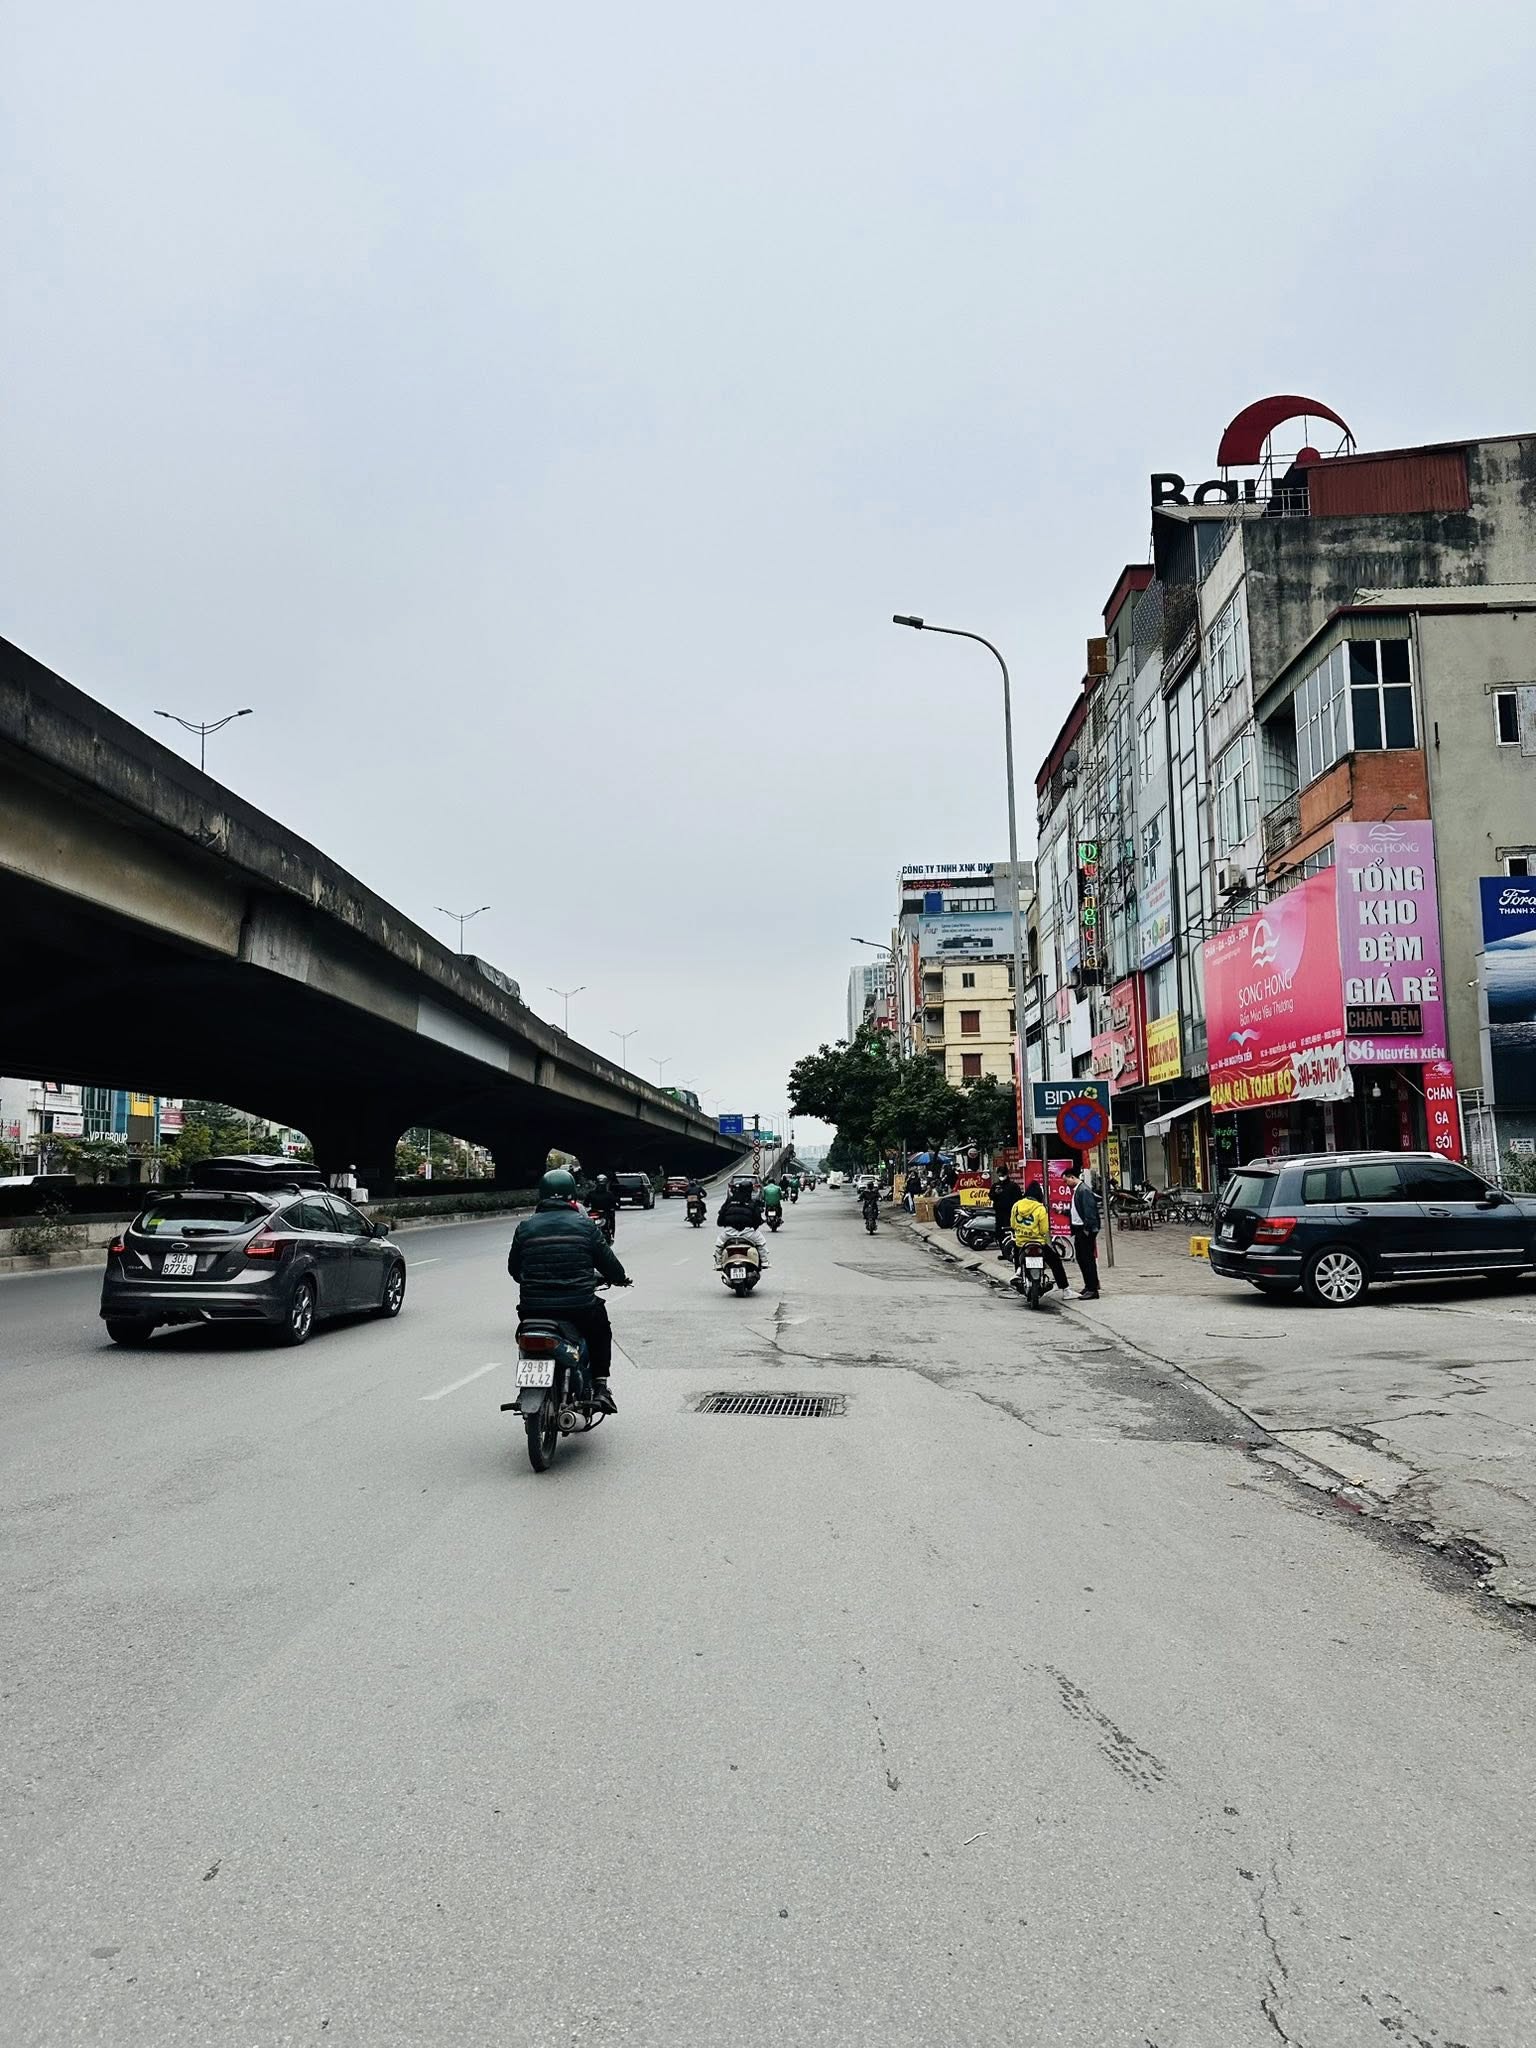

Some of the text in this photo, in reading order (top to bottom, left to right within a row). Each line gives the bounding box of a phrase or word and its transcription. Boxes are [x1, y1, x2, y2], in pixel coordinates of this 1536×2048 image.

[1349, 842, 1420, 854] SONG HONG
[902, 864, 924, 874] CÔNG
[925, 865, 935, 873] TY
[936, 864, 958, 873] TNHH
[959, 863, 976, 872] XNK
[1347, 857, 1425, 892] TỔNG
[1358, 899, 1418, 925] KHO
[1358, 931, 1423, 967] ĐỆM
[1238, 968, 1293, 1008] SONG HONG
[1346, 968, 1441, 1004] GIÁ RẺ
[886, 970, 898, 1032] HOTEL
[1348, 1040, 1375, 1060] 86
[1426, 1084, 1454, 1101] CHĂN
[1434, 1111, 1450, 1124] GA
[1435, 1129, 1453, 1149] GỐI
[1058, 1185, 1072, 1196] GA
[517, 1373, 551, 1386] 414.42
